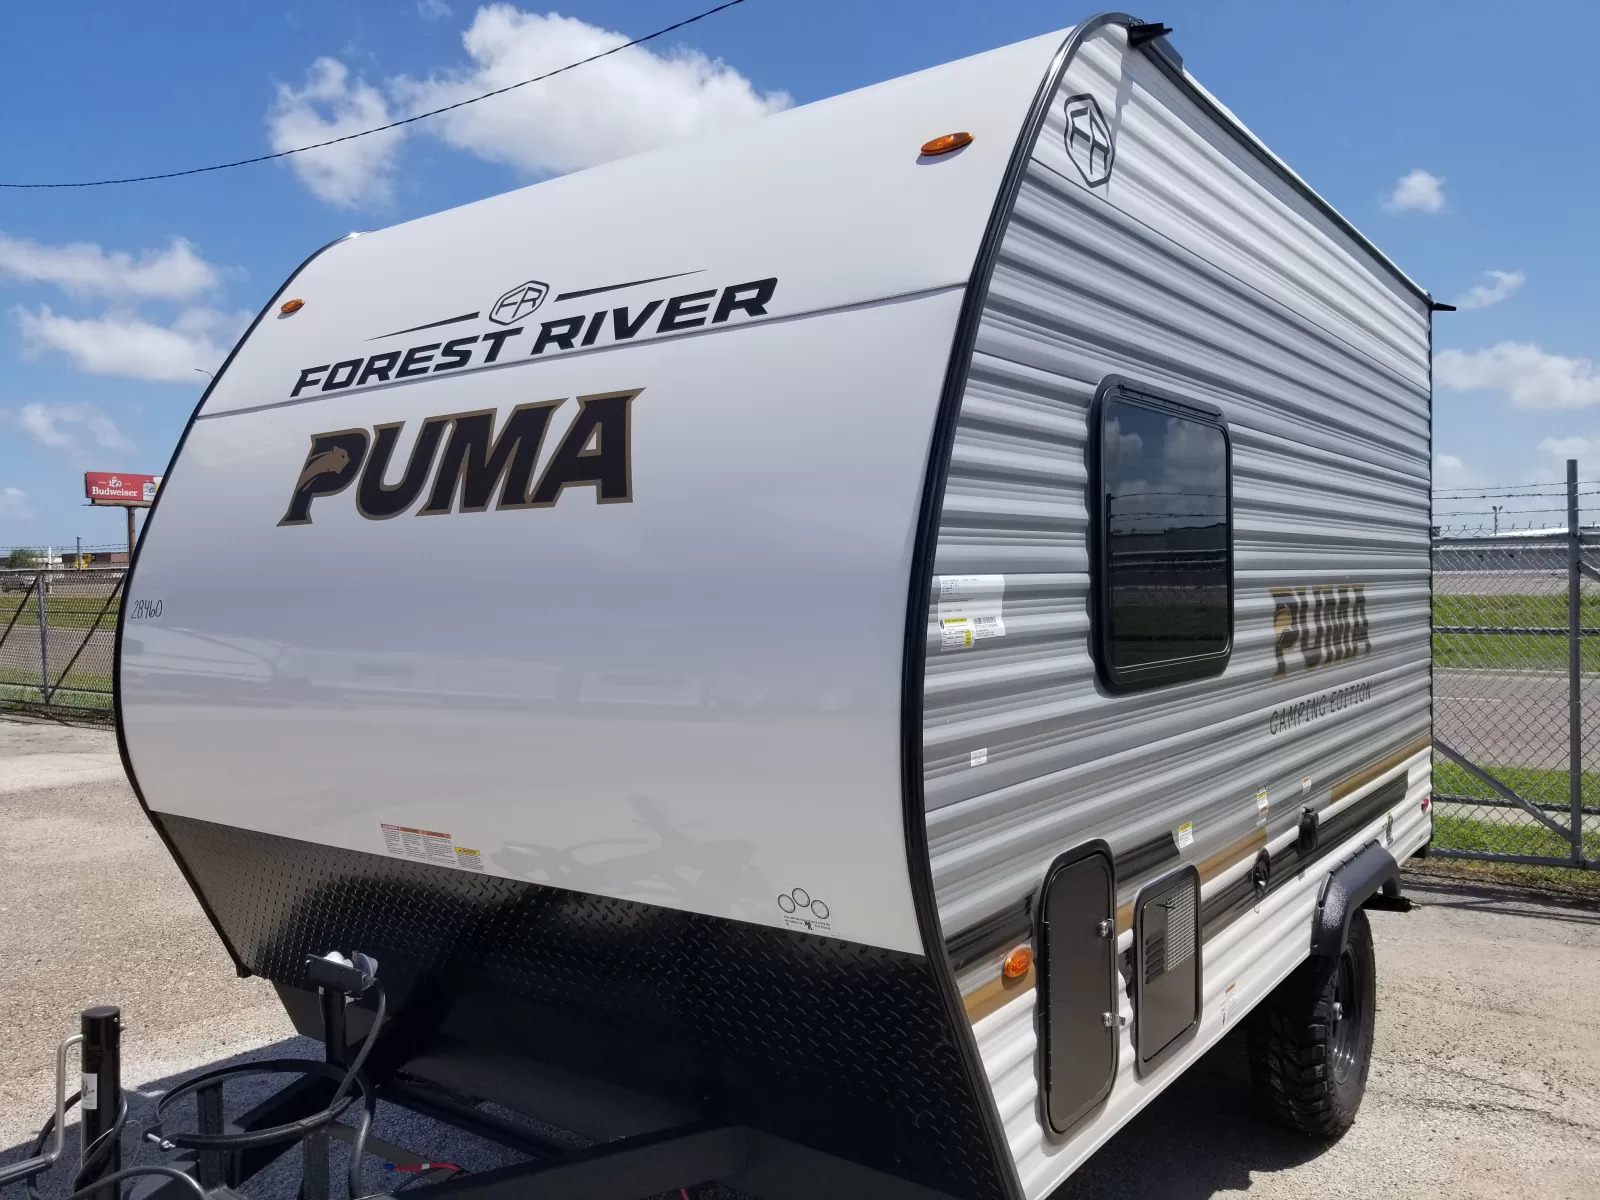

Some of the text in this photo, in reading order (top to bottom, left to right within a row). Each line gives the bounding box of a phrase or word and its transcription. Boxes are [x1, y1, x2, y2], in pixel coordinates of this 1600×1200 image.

[290, 277, 778, 397] FOREST RIVER
[92, 486, 138, 497] Budweiser
[277, 387, 646, 527] PUMA
[130, 599, 163, 619] 28460
[1269, 584, 1372, 680] PUMA
[1269, 680, 1373, 736] CAMPING EDITION
